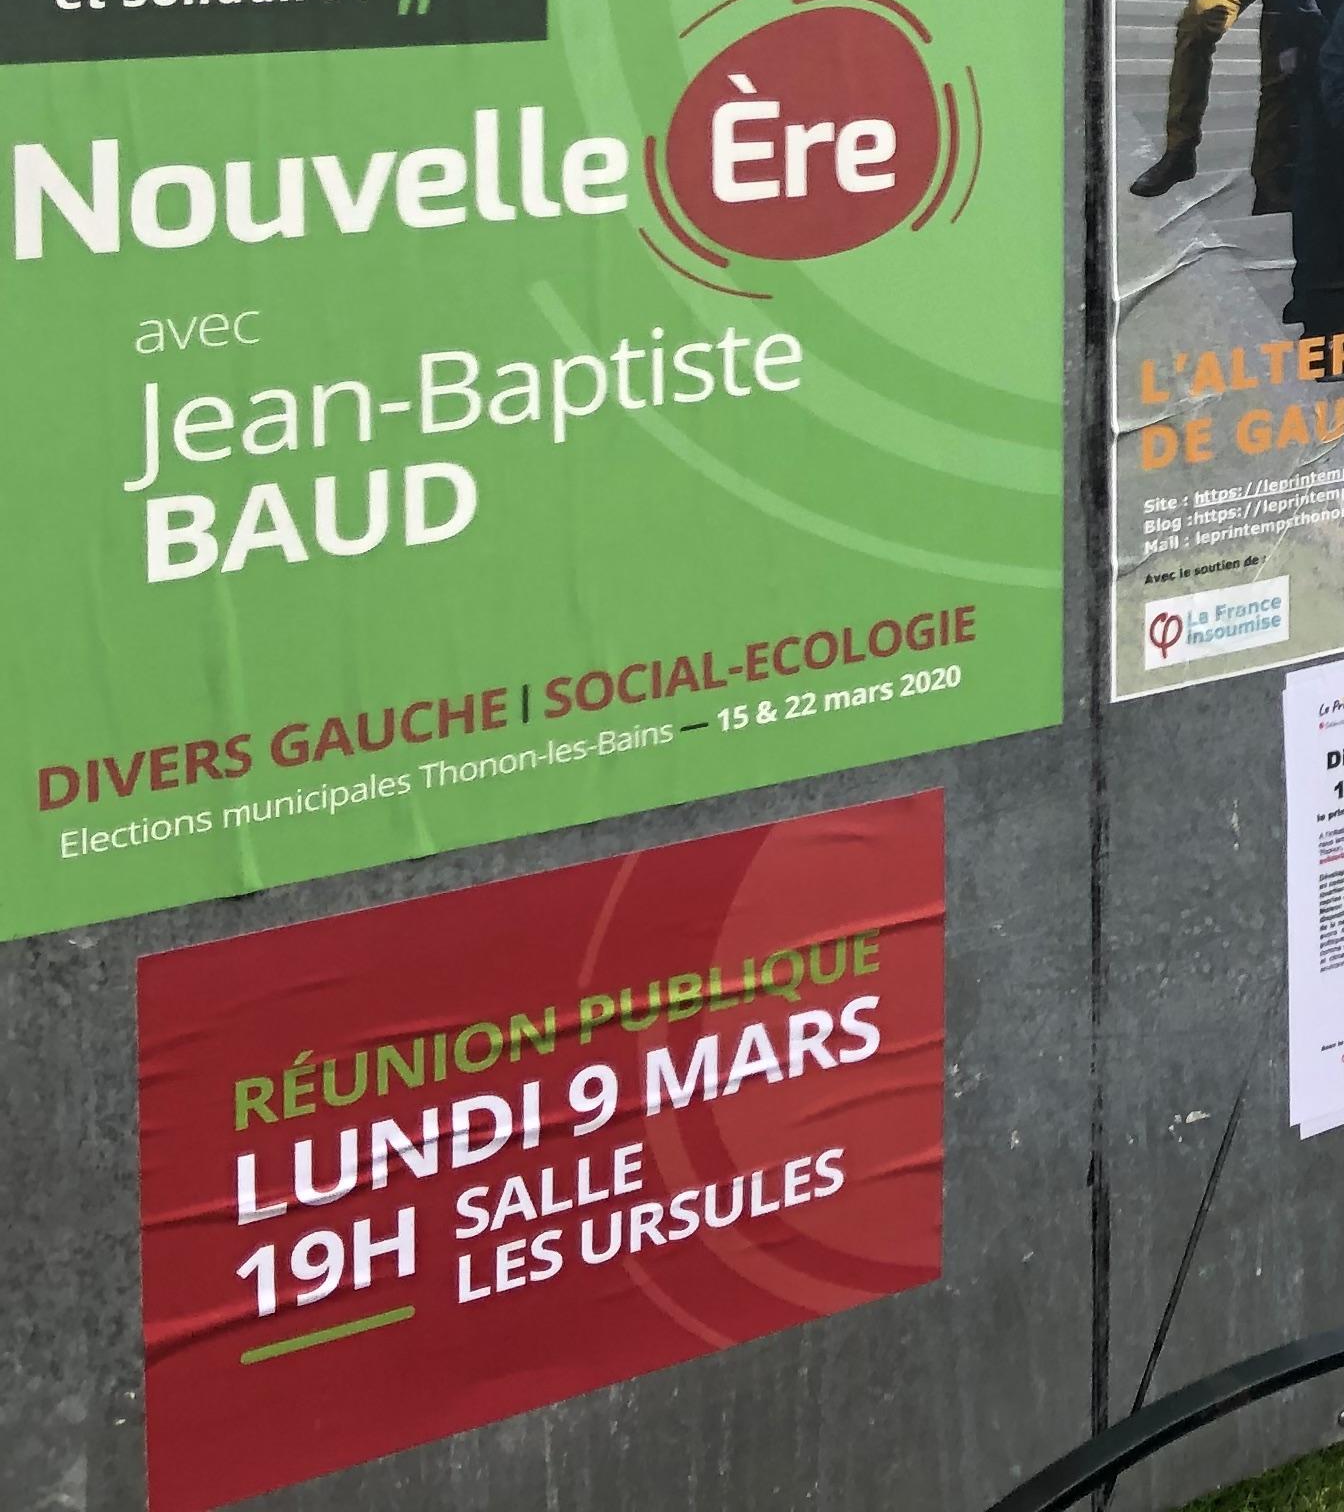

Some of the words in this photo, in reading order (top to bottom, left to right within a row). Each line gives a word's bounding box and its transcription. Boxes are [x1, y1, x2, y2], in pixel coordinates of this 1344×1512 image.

[12, 106, 630, 260] Nouvelle
[711, 73, 897, 204] Ère
[124, 324, 802, 492] Jean-Baptiste
[135, 308, 260, 355] avec
[144, 460, 477, 583] BAUD
[1141, 415, 1213, 471] DE
[1215, 594, 1282, 624] France
[38, 732, 252, 813] DIVERS
[269, 687, 509, 770] GAUCHE
[545, 605, 978, 720] SOCIAL-ECOLOGIE
[58, 806, 215, 859] Elections
[222, 769, 412, 833] municipales
[419, 722, 674, 790] Thonon-les-Bains
[823, 679, 893, 711] mars
[899, 664, 962, 699] 2020
[234, 1006, 558, 1131] RÉUNION
[579, 929, 881, 1046] PUBLIQUE
[235, 1084, 541, 1227] LUNDI
[569, 1064, 617, 1137] 9
[644, 995, 883, 1119] MARS
[235, 1206, 416, 1318] 19H
[454, 1143, 644, 1241] SALLE
[457, 1230, 564, 1304] LES
[577, 1148, 847, 1266] URSULES
